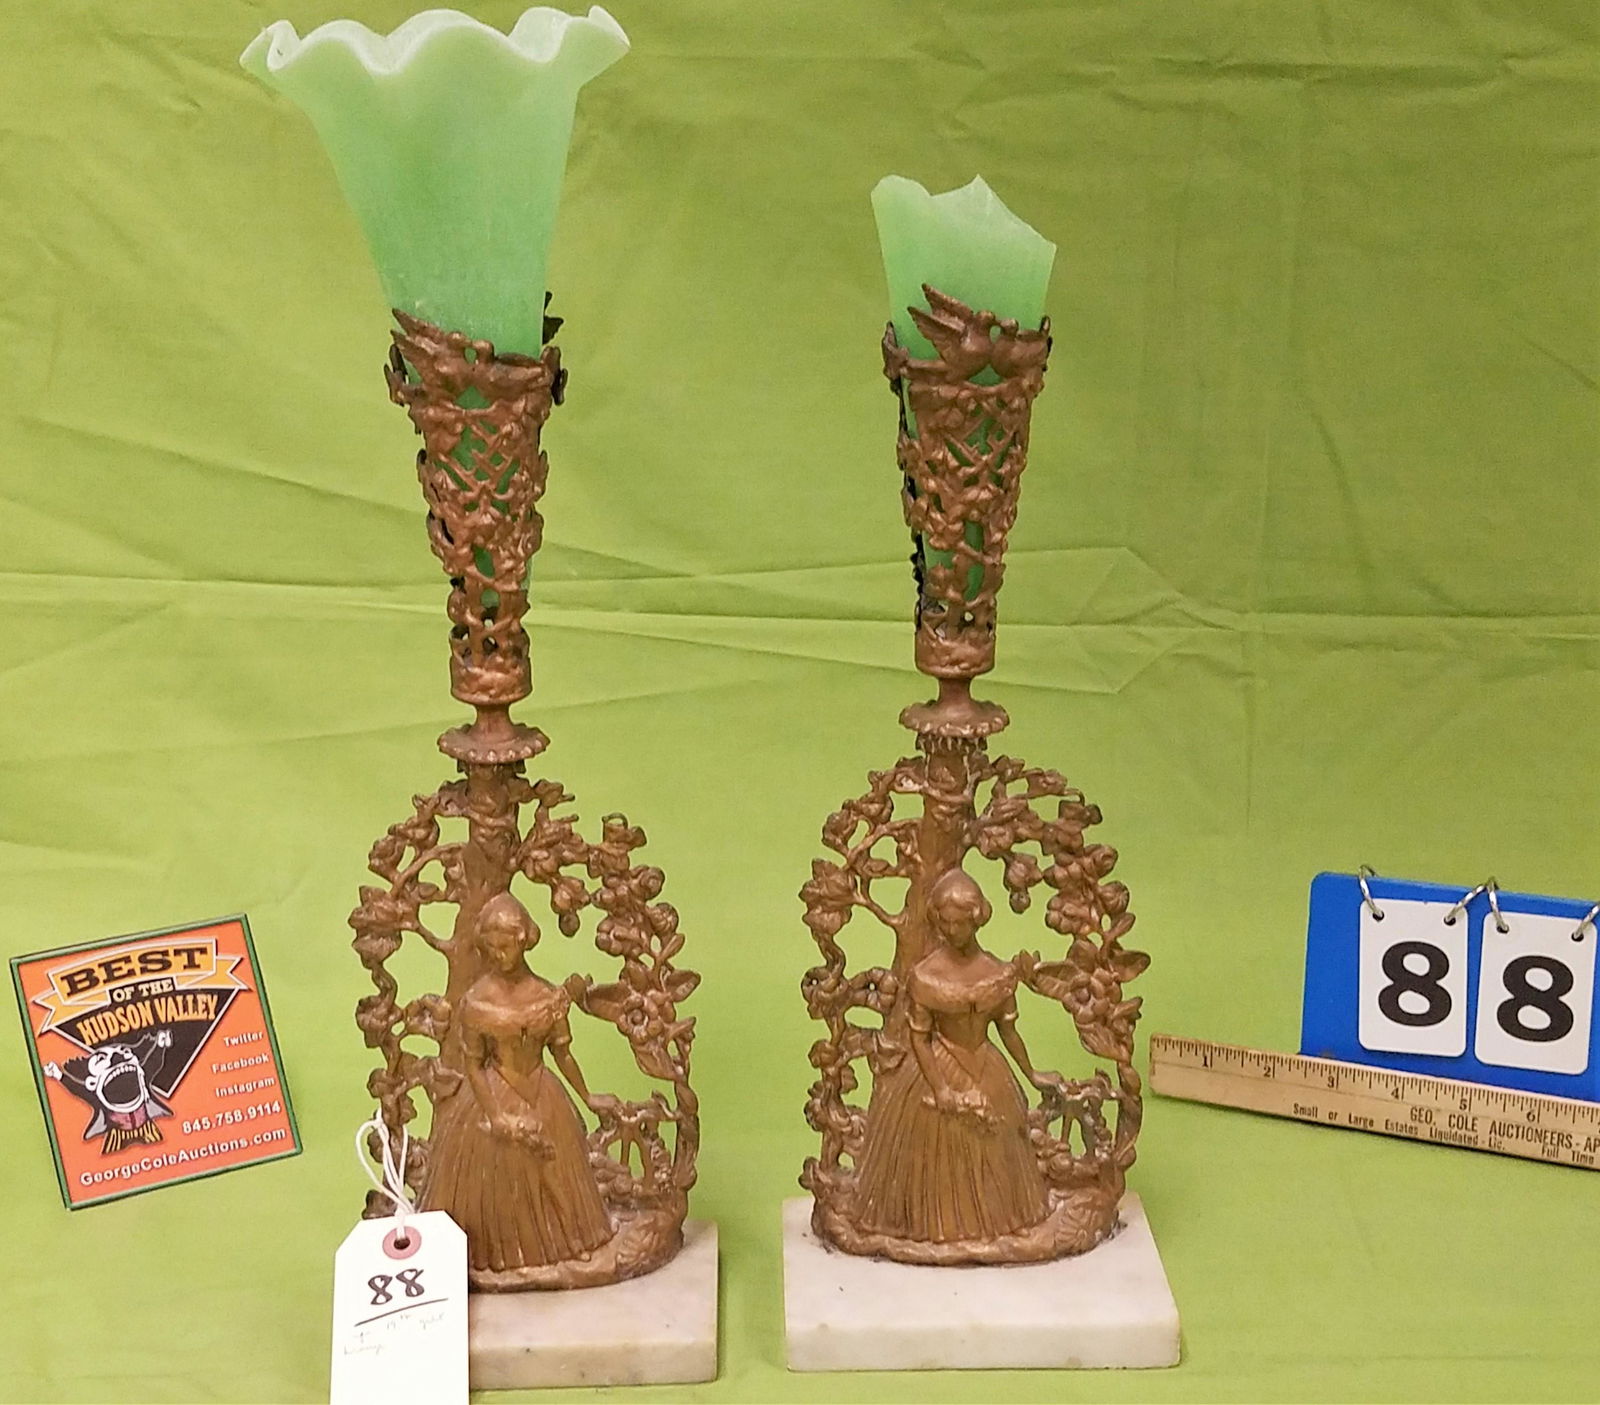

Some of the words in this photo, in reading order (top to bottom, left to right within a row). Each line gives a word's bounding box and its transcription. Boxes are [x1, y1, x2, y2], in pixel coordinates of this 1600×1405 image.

[60, 947, 208, 997] BEST
[112, 987, 136, 1003] OF
[138, 978, 175, 996] THE
[76, 999, 153, 1046] HUDSON
[153, 993, 219, 1022] VALLEY
[223, 1031, 264, 1048] Twitter
[211, 1053, 270, 1075] Facebook
[214, 1076, 276, 1098] Instagram
[1263, 1064, 1272, 1079] 2
[1327, 1076, 1335, 1089] 3
[1390, 1087, 1400, 1101] 4
[1459, 1099, 1468, 1111] 5
[1526, 1109, 1536, 1123] 6
[181, 1101, 282, 1135] 845.758.9114
[1293, 1102, 1318, 1119] Small
[1328, 1111, 1338, 1121] or
[1348, 1112, 1375, 1129] Large
[1385, 1118, 1418, 1136] Estates
[1429, 1126, 1479, 1146] Liquidated
[1542, 1144, 1559, 1158] Full
[1571, 1150, 1595, 1165] Time
[1410, 1106, 1437, 1126] GEO.
[1448, 1114, 1479, 1133] COLE
[79, 1126, 287, 1187] GeorgeColeAuctions.com
[367, 1268, 425, 1306] 88
